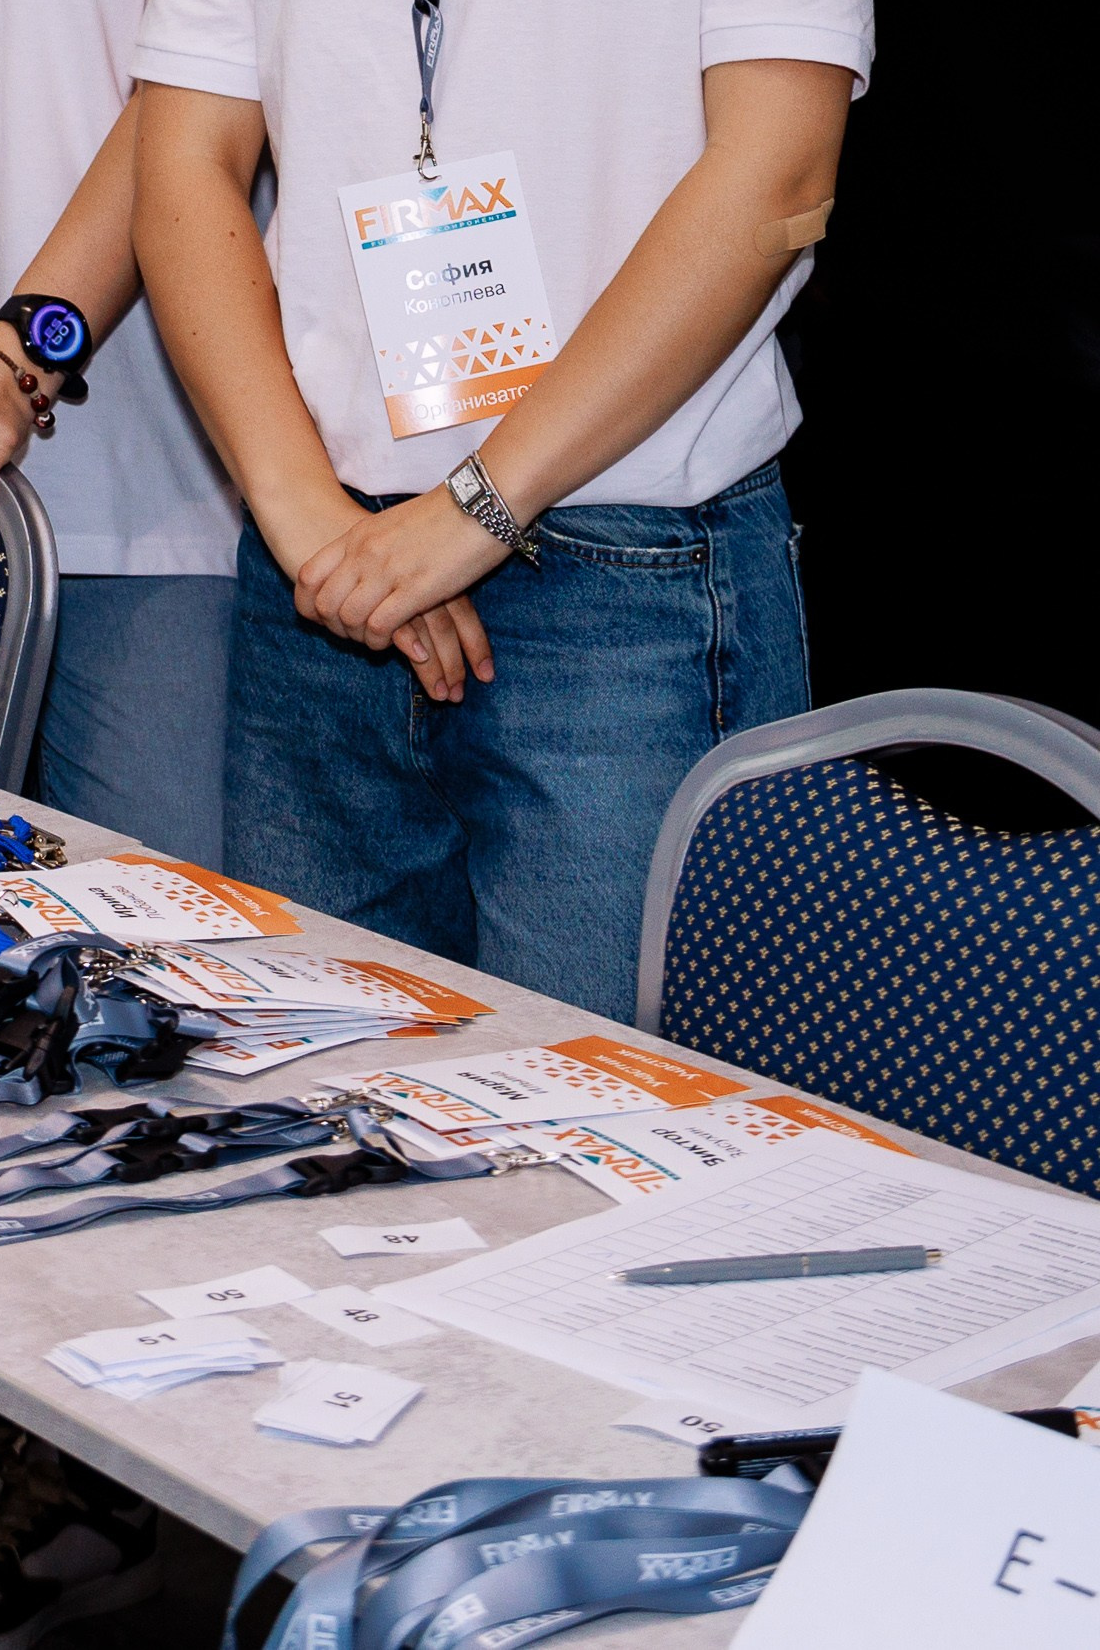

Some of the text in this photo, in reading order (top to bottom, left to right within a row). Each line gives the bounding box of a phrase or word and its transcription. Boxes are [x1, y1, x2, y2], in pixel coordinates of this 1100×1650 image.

[354, 178, 514, 241] FIRMAX
[405, 259, 493, 291] София
[404, 282, 507, 316] Коноплева
[414, 384, 533, 420] Организато
[88, 887, 138, 919] Ирина
[215, 883, 271, 917] Участник
[592, 1054, 668, 1088] Участник
[614, 1049, 702, 1081] Участник
[351, 1071, 491, 1123] FIRMAX
[457, 1071, 529, 1101] Мария
[652, 1128, 725, 1167] Виктор
[207, 1288, 246, 1303] 50
[343, 1307, 380, 1323] 48
[139, 1333, 177, 1346] 51
[323, 1391, 364, 1410] 51
[680, 1416, 725, 1434] 50
